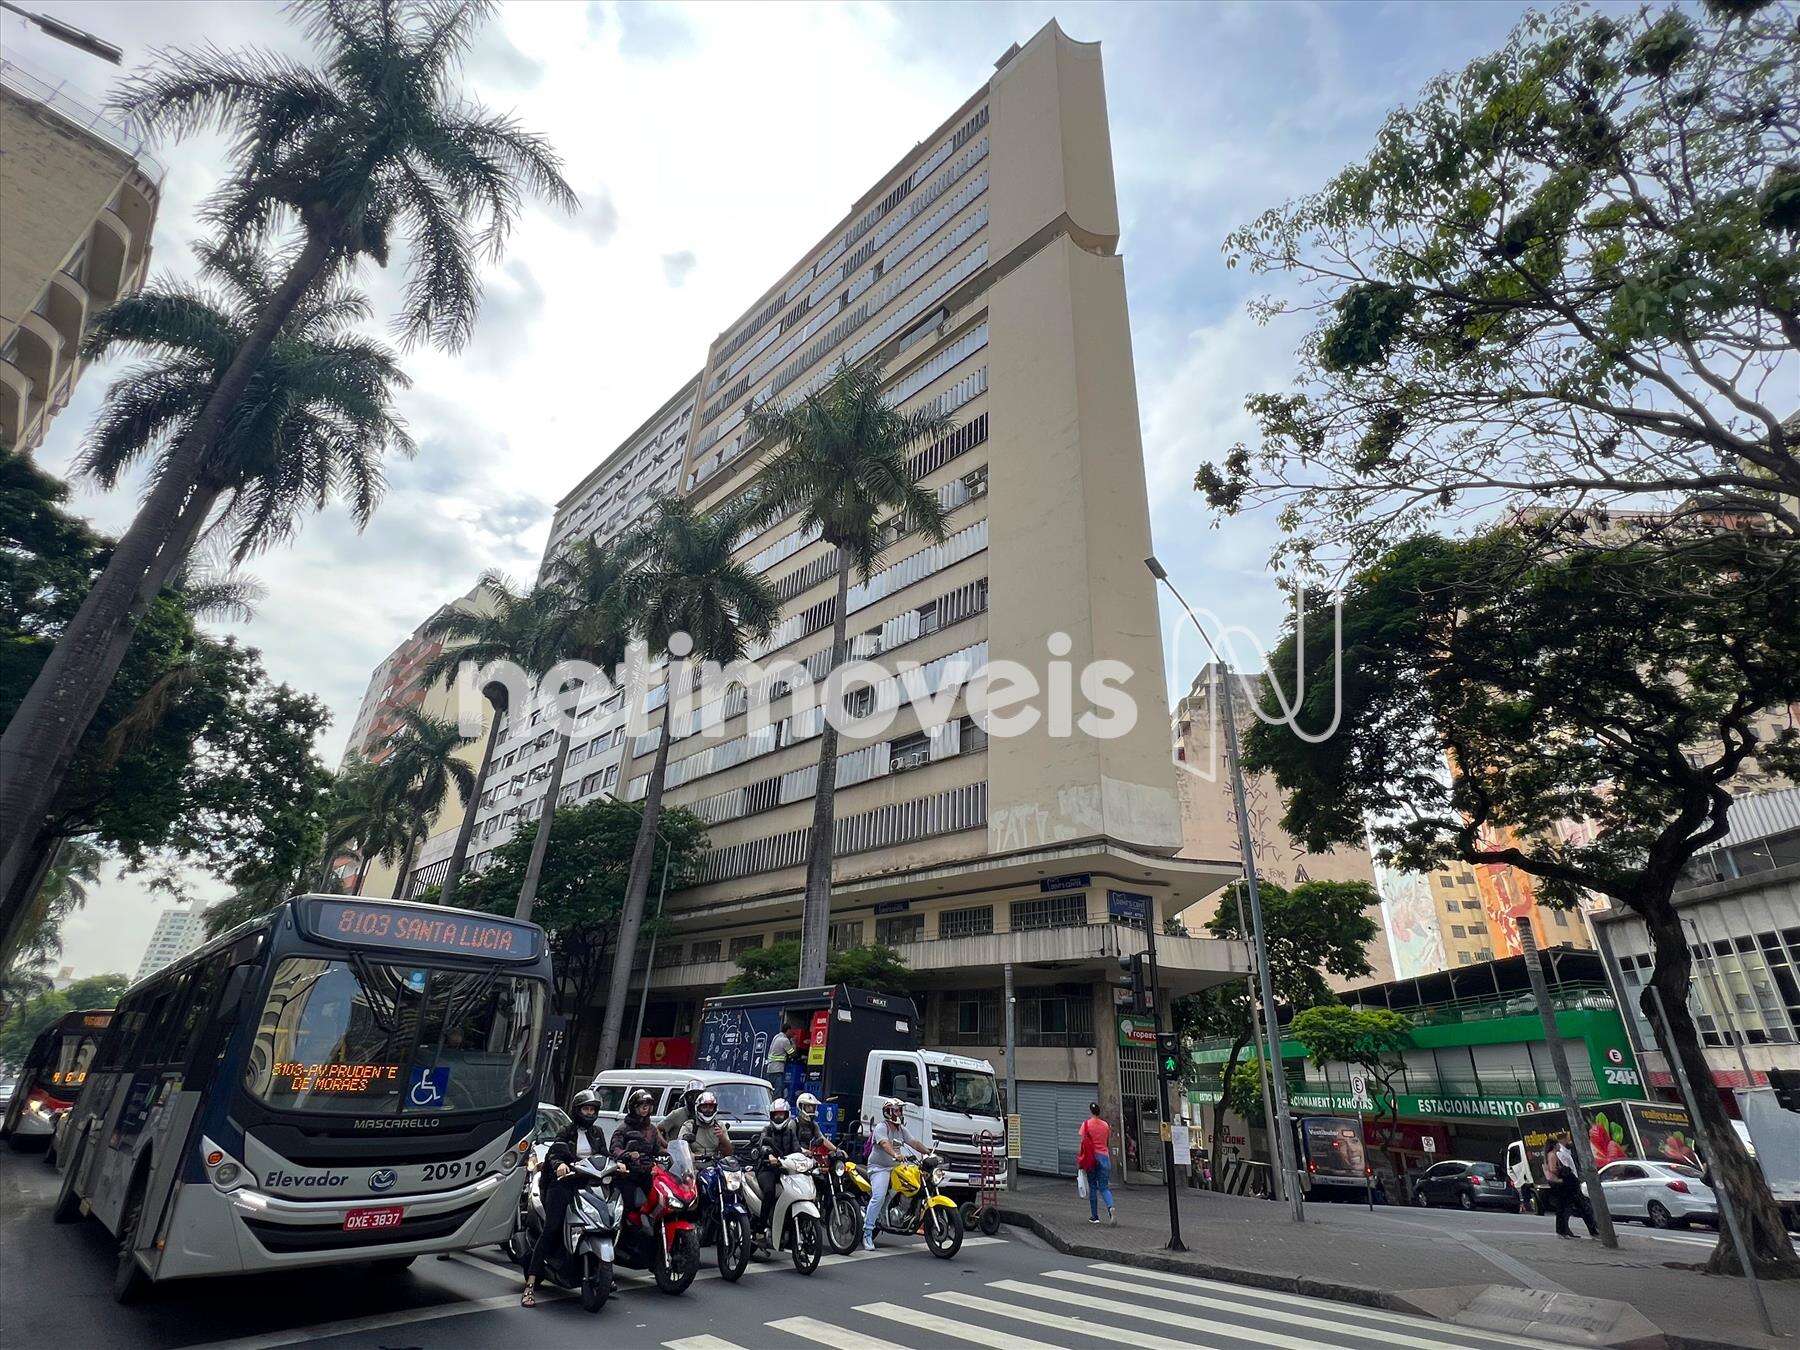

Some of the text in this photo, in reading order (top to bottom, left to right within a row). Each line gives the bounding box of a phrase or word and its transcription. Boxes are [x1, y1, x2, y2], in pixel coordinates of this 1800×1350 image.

[337, 909, 513, 951] 8103 SANTA LUCIA
[291, 1077, 369, 1091] DE MORAES
[1605, 1069, 1640, 1086] 24H
[1417, 1099, 1525, 1116] ESTACIONAMENTO
[354, 1118, 440, 1129] MASCARELLO
[265, 1160, 487, 1188] Elevador 20919
